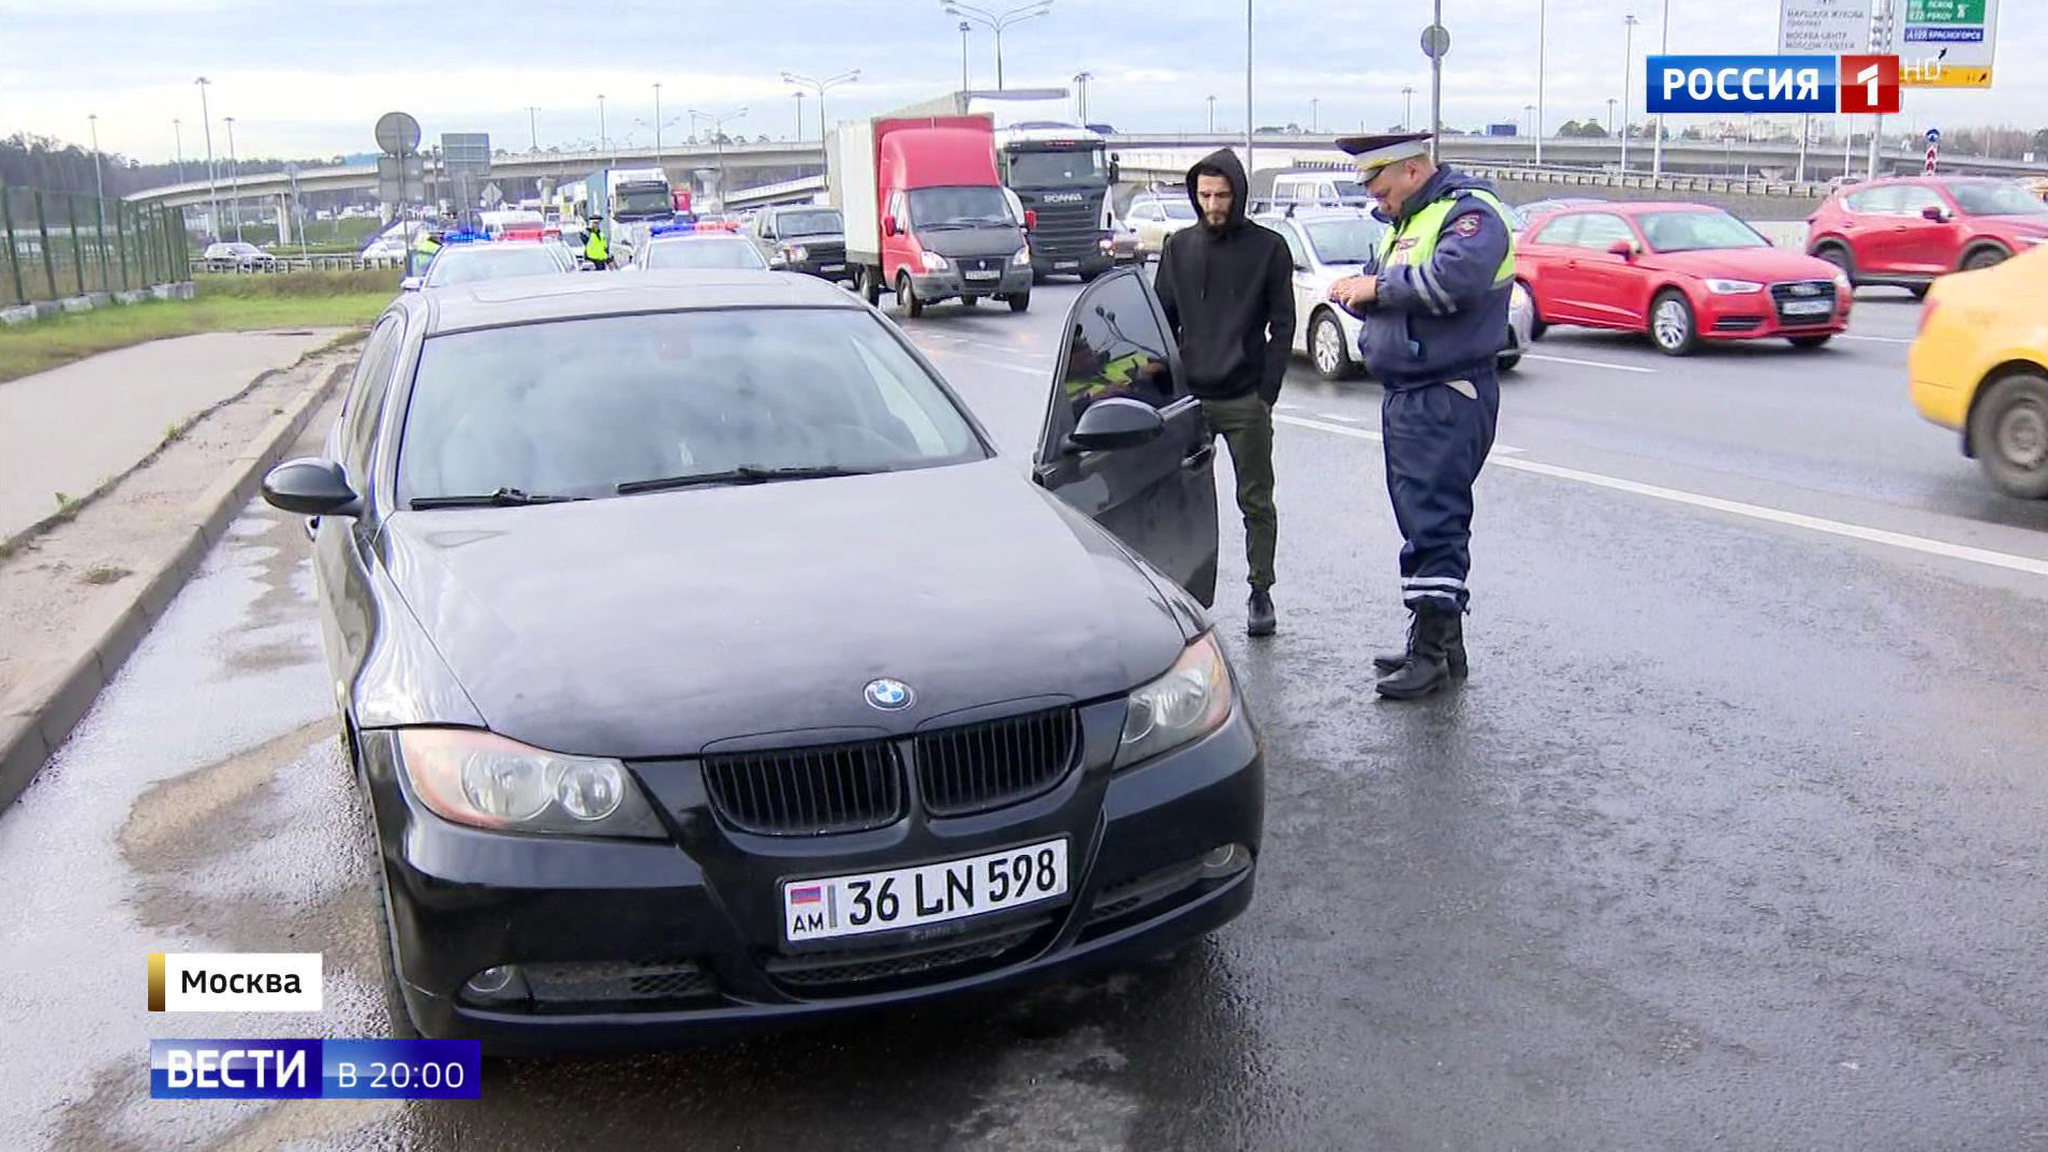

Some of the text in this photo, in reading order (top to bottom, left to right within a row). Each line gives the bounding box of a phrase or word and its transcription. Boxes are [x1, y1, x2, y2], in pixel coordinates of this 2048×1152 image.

[848, 849, 1056, 925] 36 LN 598
[793, 913, 824, 934] AM
